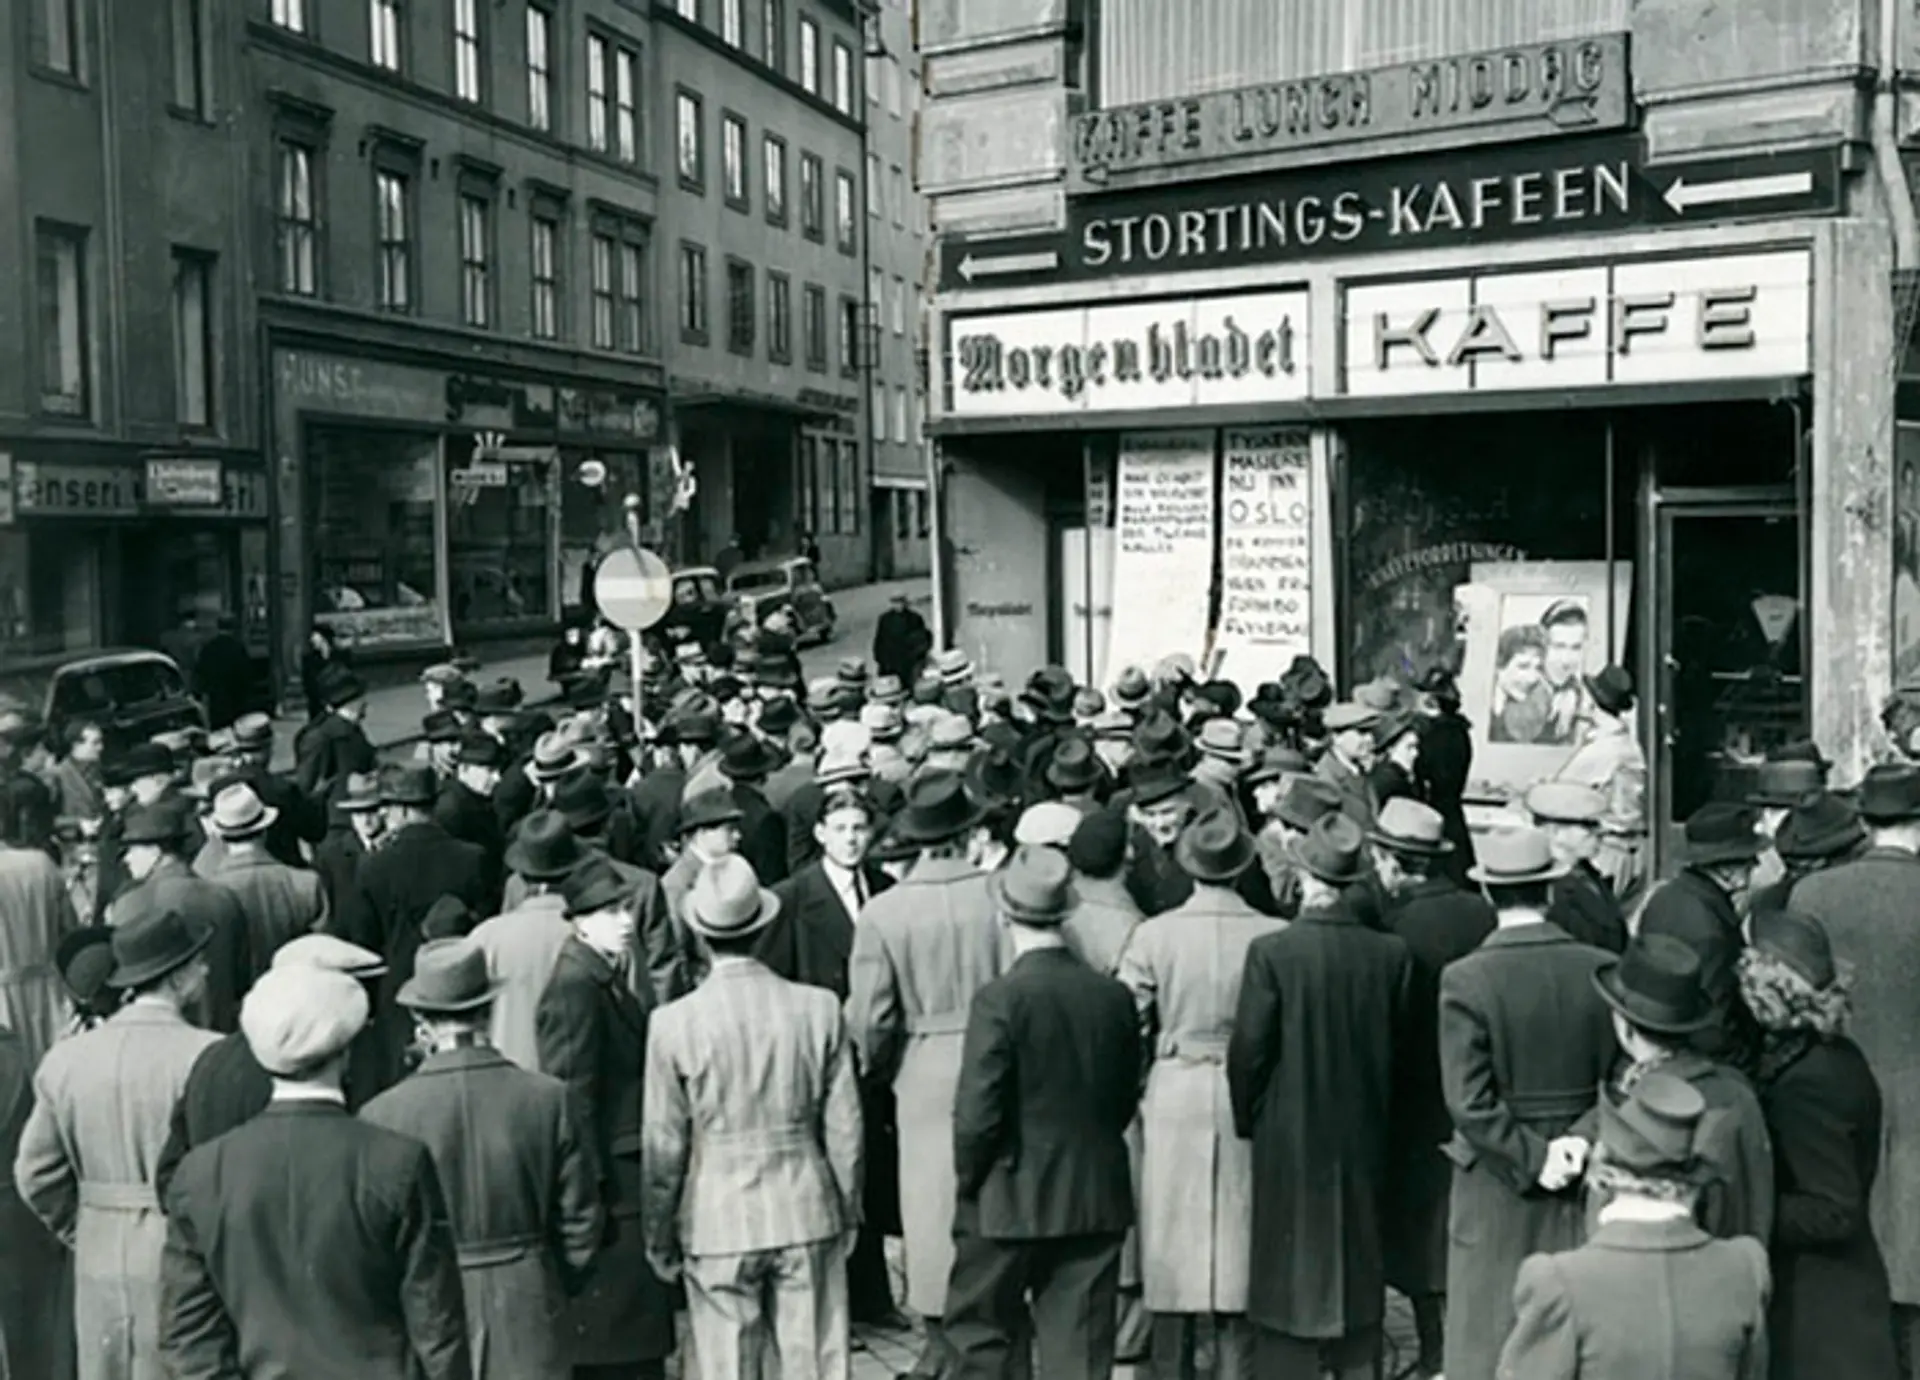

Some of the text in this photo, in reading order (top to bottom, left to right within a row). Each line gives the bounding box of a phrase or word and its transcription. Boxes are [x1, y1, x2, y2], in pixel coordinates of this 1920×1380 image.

[1076, 40, 1606, 163] KAFFE LUNCH MIDDAG
[1082, 161, 1631, 265] STORTINGS-KAFEEN
[958, 315, 1296, 396] Morgenbladet
[1374, 285, 1757, 371] KAFFE
[1229, 498, 1306, 525] OSLO
